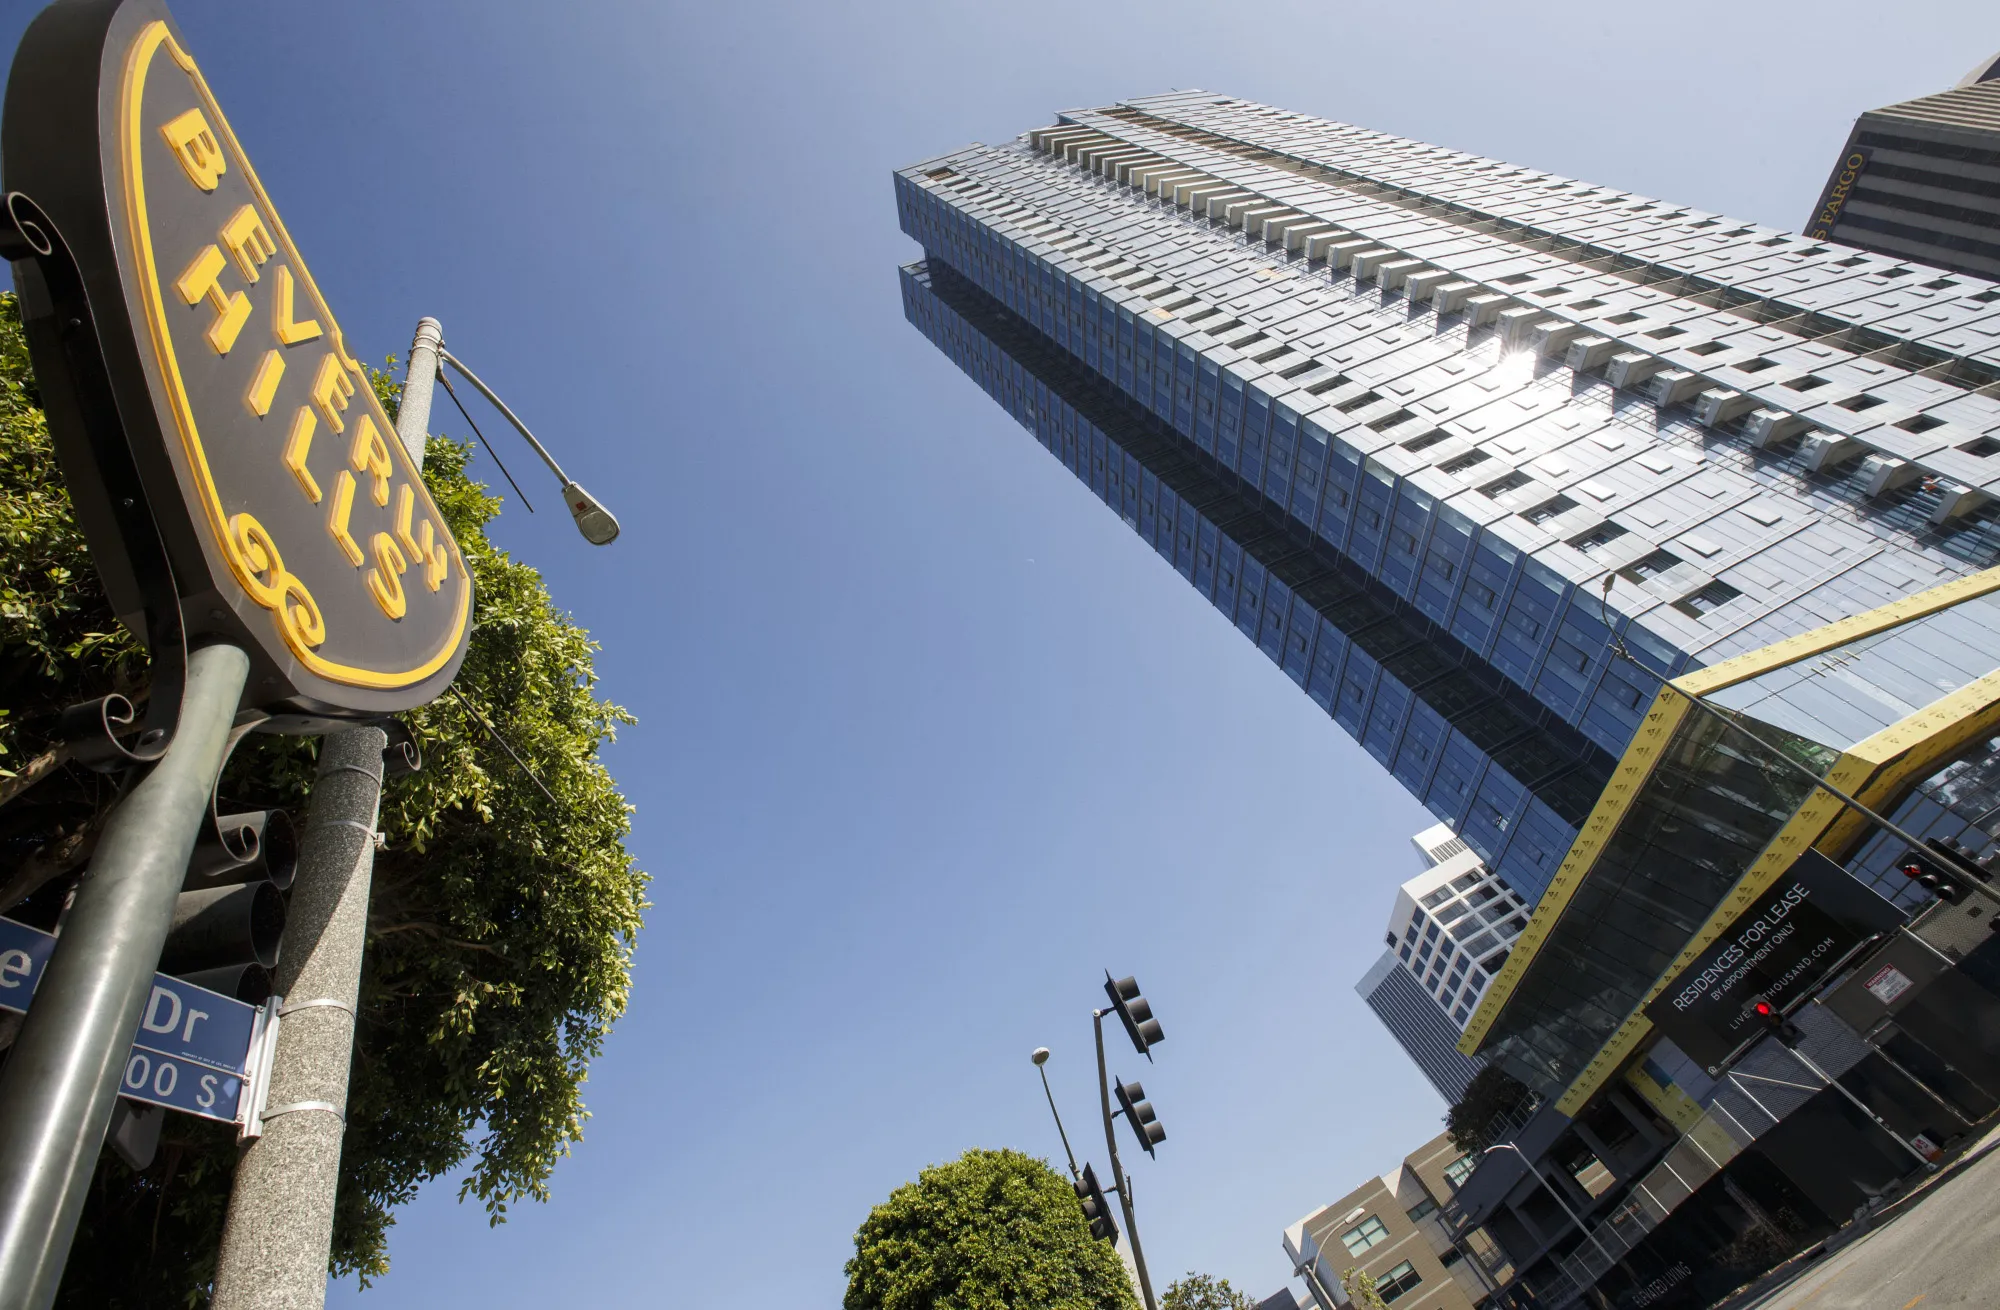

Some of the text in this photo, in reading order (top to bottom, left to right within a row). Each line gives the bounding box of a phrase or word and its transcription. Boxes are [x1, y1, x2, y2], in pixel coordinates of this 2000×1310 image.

[1819, 153, 1864, 226] FARGO
[160, 107, 448, 592] BEVERLY
[177, 244, 407, 620] HILLS
[1672, 882, 1811, 1012] RESIDENCES FOR LEASE
[1710, 922, 1796, 1001] BY APPOINTMENT ONLY
[142, 985, 209, 1043] Dr
[125, 1054, 218, 1108] 00 S
[1632, 1261, 1692, 1308] ELEVATED LIVING
